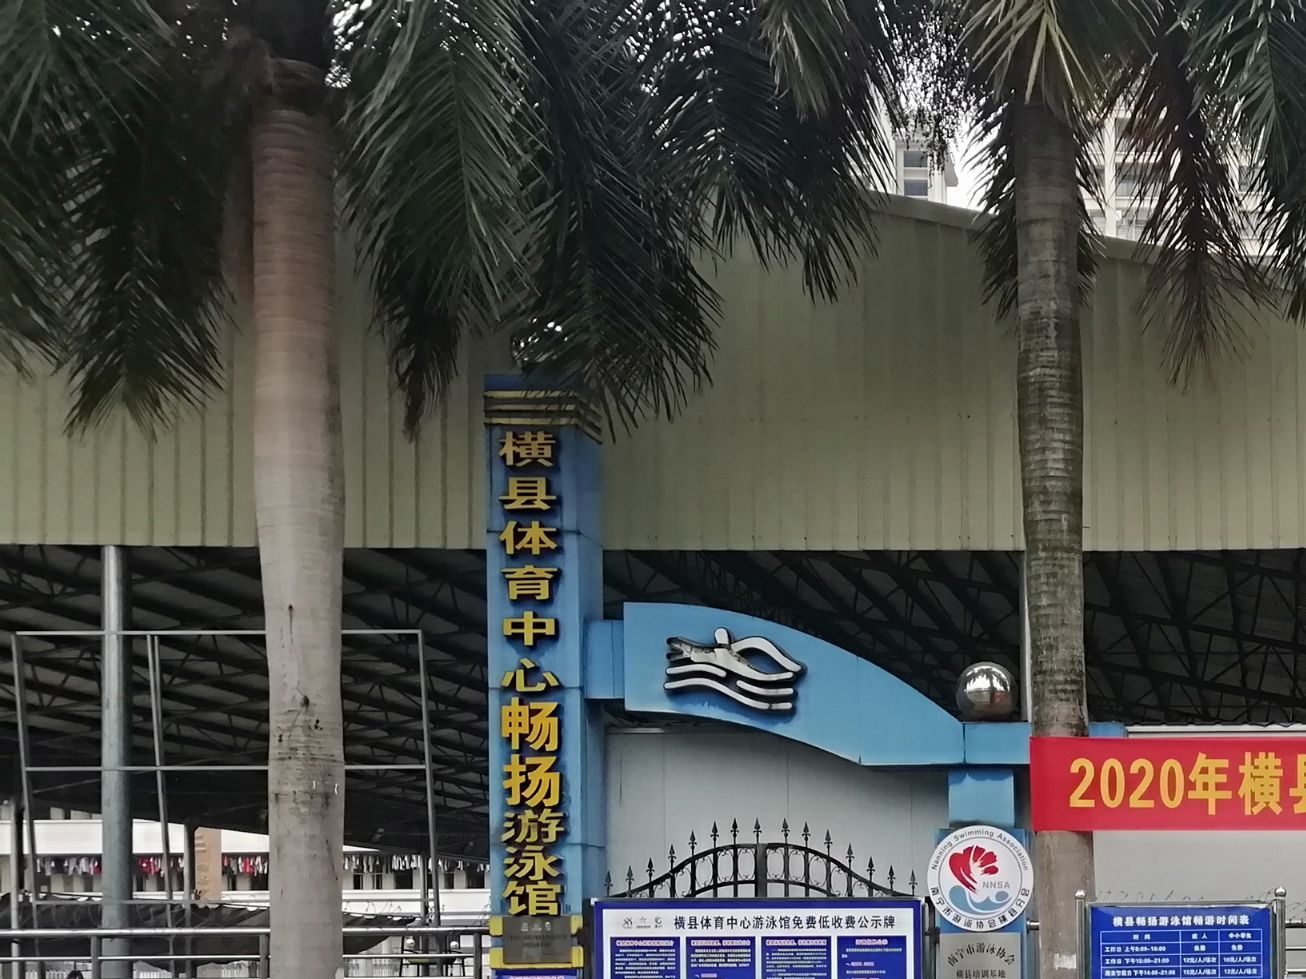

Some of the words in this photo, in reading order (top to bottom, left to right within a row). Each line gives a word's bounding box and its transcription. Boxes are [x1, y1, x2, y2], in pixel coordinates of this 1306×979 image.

[499, 430, 564, 916] 横县体育中心畅扬游泳馆
[932, 841, 953, 870] Nanning
[953, 829, 994, 841] Swimming
[997, 833, 1028, 871] Association
[982, 881, 1010, 889] NNSA
[674, 915, 896, 930] 横县体育中心游泳馆免费低收费公示牌
[1113, 915, 1249, 926] 横县畅扬游泳馆畅游时间表
[947, 942, 1015, 967] 南宁市游泳协会
[956, 969, 1006, 979] 横县培训基地
